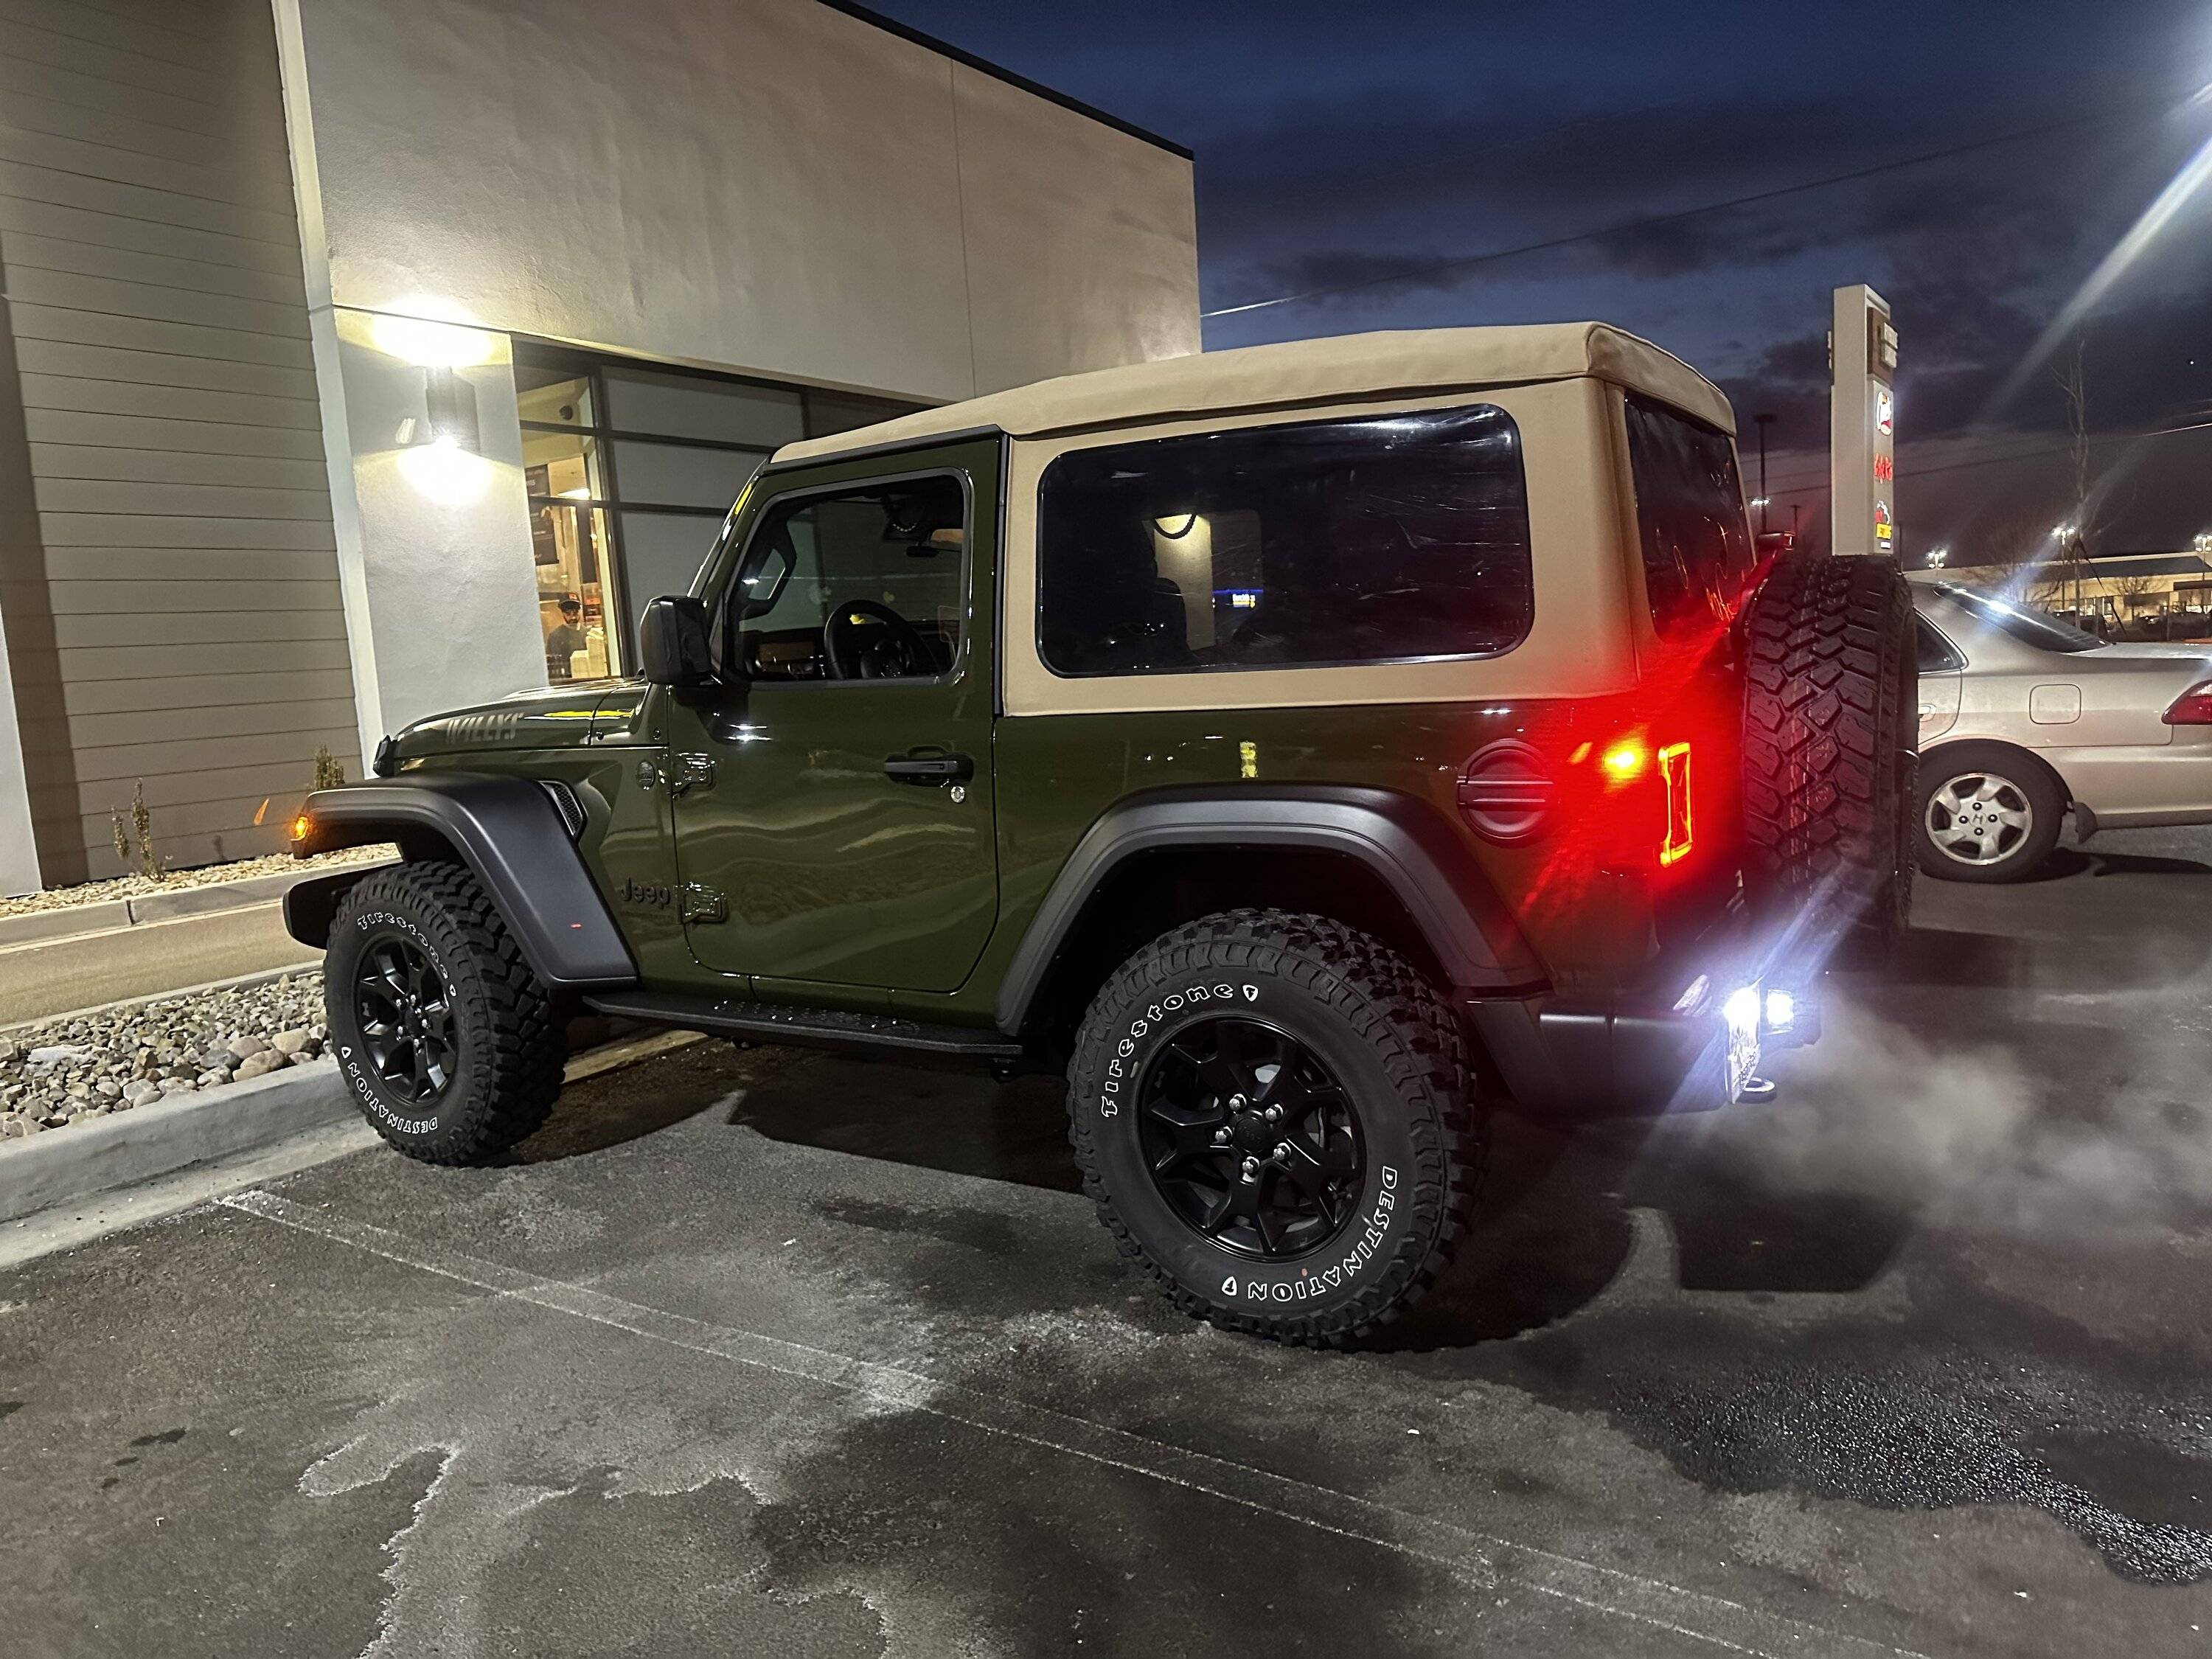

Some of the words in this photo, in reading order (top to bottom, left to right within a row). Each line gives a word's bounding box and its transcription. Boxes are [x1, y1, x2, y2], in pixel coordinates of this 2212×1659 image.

[446, 712, 524, 743] WILLYS
[619, 877, 670, 910] Jeep
[358, 911, 449, 979] Firestone
[1101, 983, 1234, 1118] Firestone
[347, 1062, 438, 1135] DESTINATION
[1248, 1166, 1399, 1302] DESTINATION
